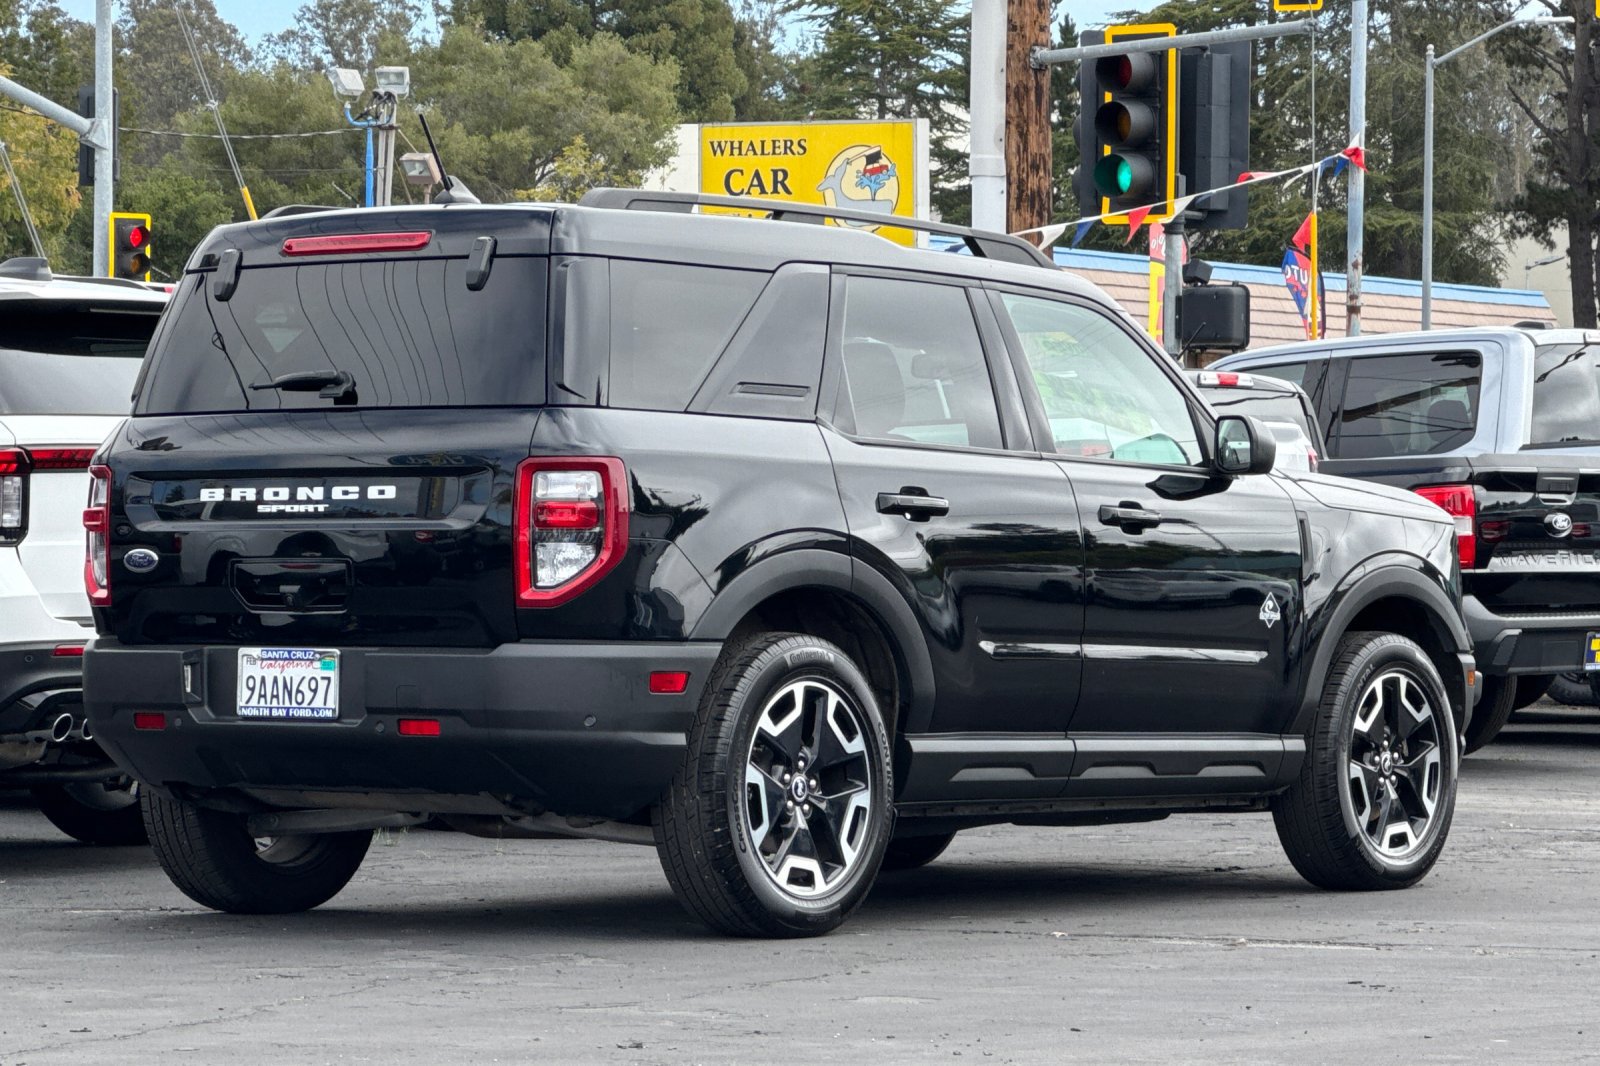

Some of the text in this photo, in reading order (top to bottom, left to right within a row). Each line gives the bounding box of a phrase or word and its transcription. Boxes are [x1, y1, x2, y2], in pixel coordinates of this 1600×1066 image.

[709, 138, 807, 157] WHALERS
[724, 168, 792, 196] CAR
[200, 485, 396, 502] BRONCO
[257, 504, 330, 513] SPORT
[261, 650, 314, 660] SANTA CRUZ
[260, 659, 314, 674] California
[245, 675, 332, 706] 9AAN697
[241, 707, 270, 716] NORTH
[271, 708, 286, 717] BAY
